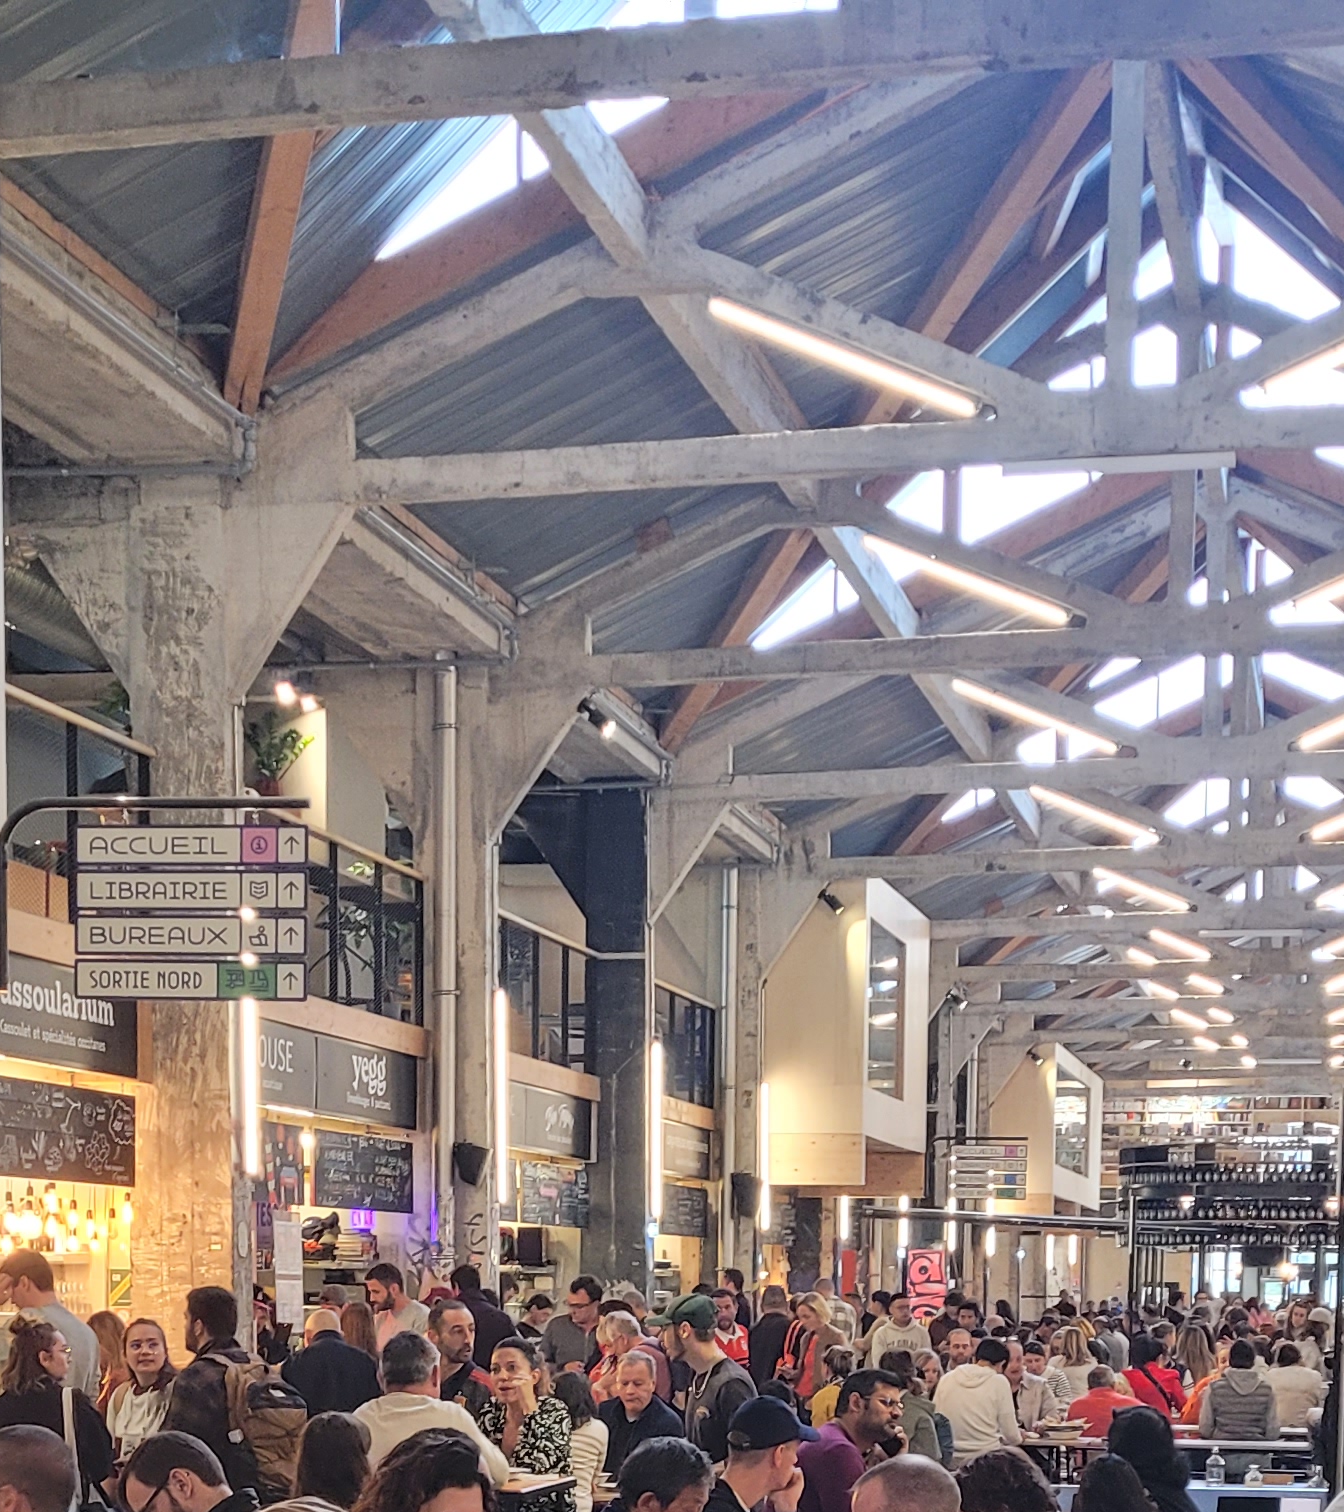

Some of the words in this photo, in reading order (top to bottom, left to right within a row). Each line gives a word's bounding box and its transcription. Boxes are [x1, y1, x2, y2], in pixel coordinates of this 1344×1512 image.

[89, 836, 228, 855] ACCUEIL
[89, 881, 228, 900] LIBRAIRIE
[89, 926, 228, 945] BUREAUX
[89, 970, 150, 989] SORTIE
[157, 970, 203, 989] NORD
[351, 1053, 388, 1097] yegg
